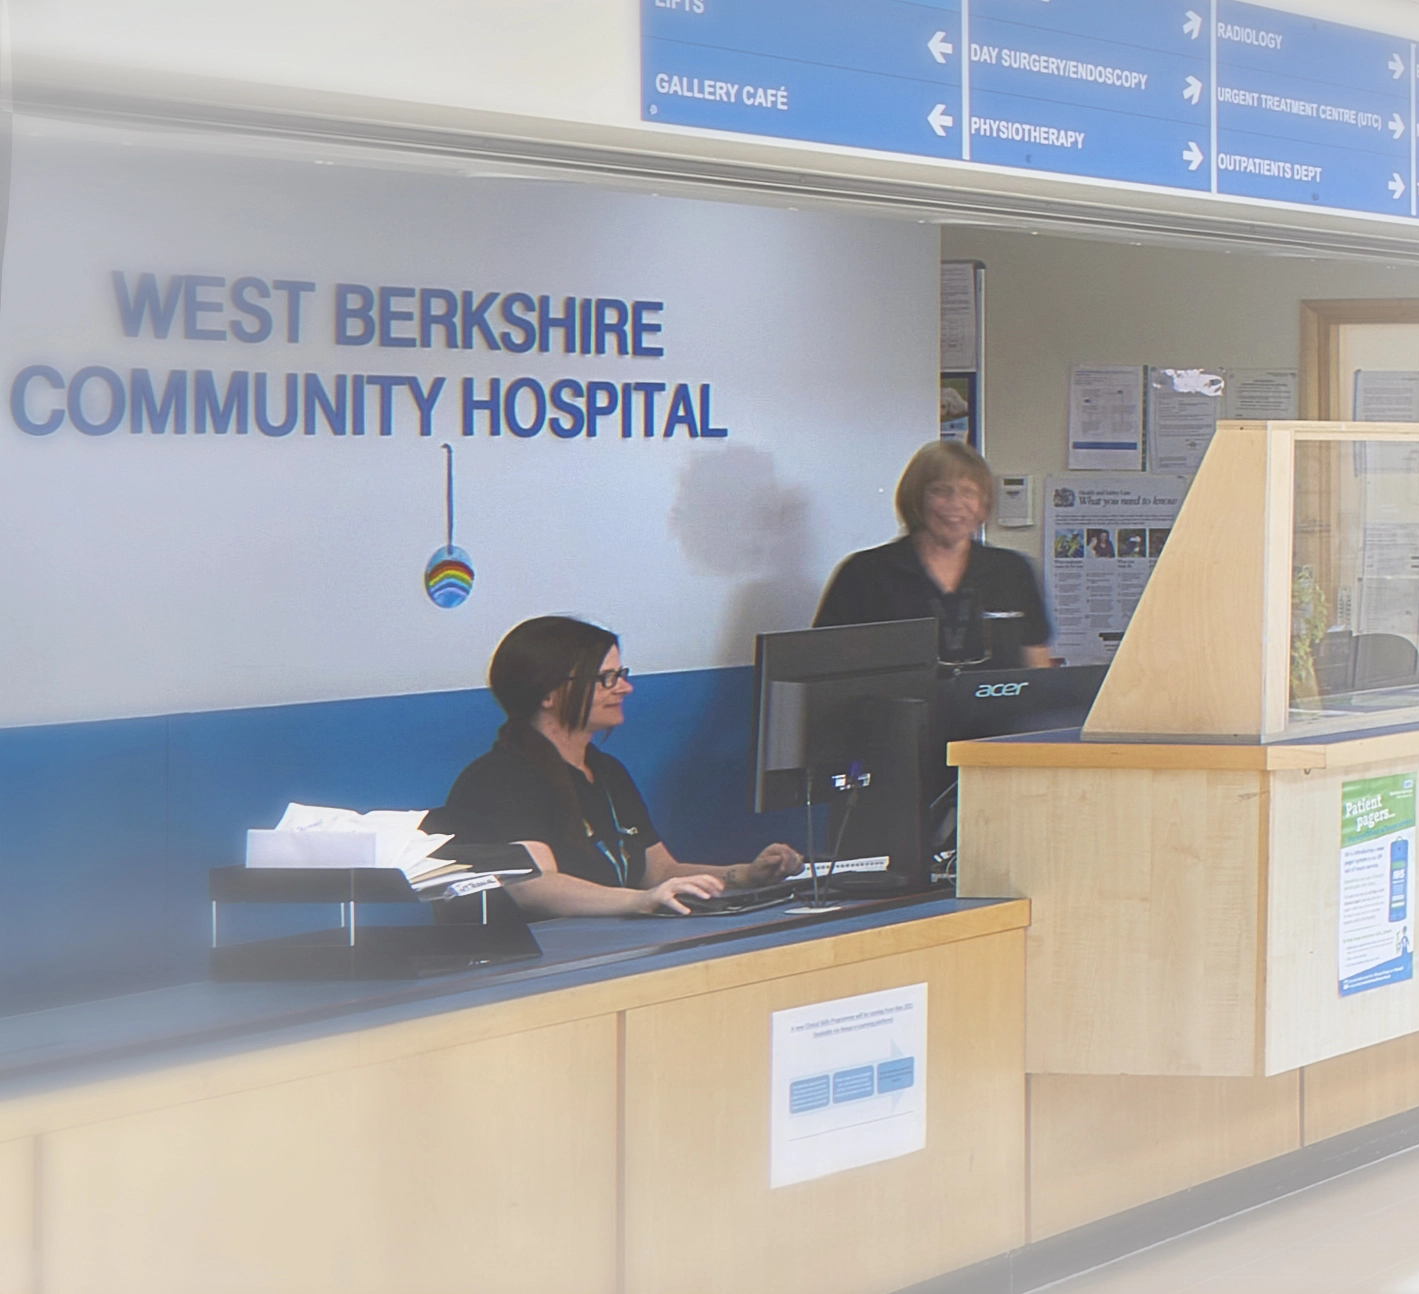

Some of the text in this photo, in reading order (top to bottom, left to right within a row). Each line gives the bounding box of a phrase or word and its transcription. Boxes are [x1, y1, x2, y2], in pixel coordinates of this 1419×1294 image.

[1217, 22, 1283, 50] RADIOLOGY
[970, 43, 1147, 90] DAY SURGERY/ENDOSCOPY
[655, 73, 788, 110] GALLERY CAFÉ
[1217, 86, 1382, 132] URGENT TREATMENT CENTRE (UTC)
[970, 116, 1085, 149] PHYSIOTHERAPY
[1217, 153, 1322, 182] OUTPATIENTS DEPT
[110, 270, 665, 358] WEST BERKSHIRE
[10, 363, 730, 440] COMMUNITY HOSPITAL
[1078, 495, 1178, 508] What you need to know
[974, 682, 1029, 698] acer
[1345, 793, 1383, 817] Patient
